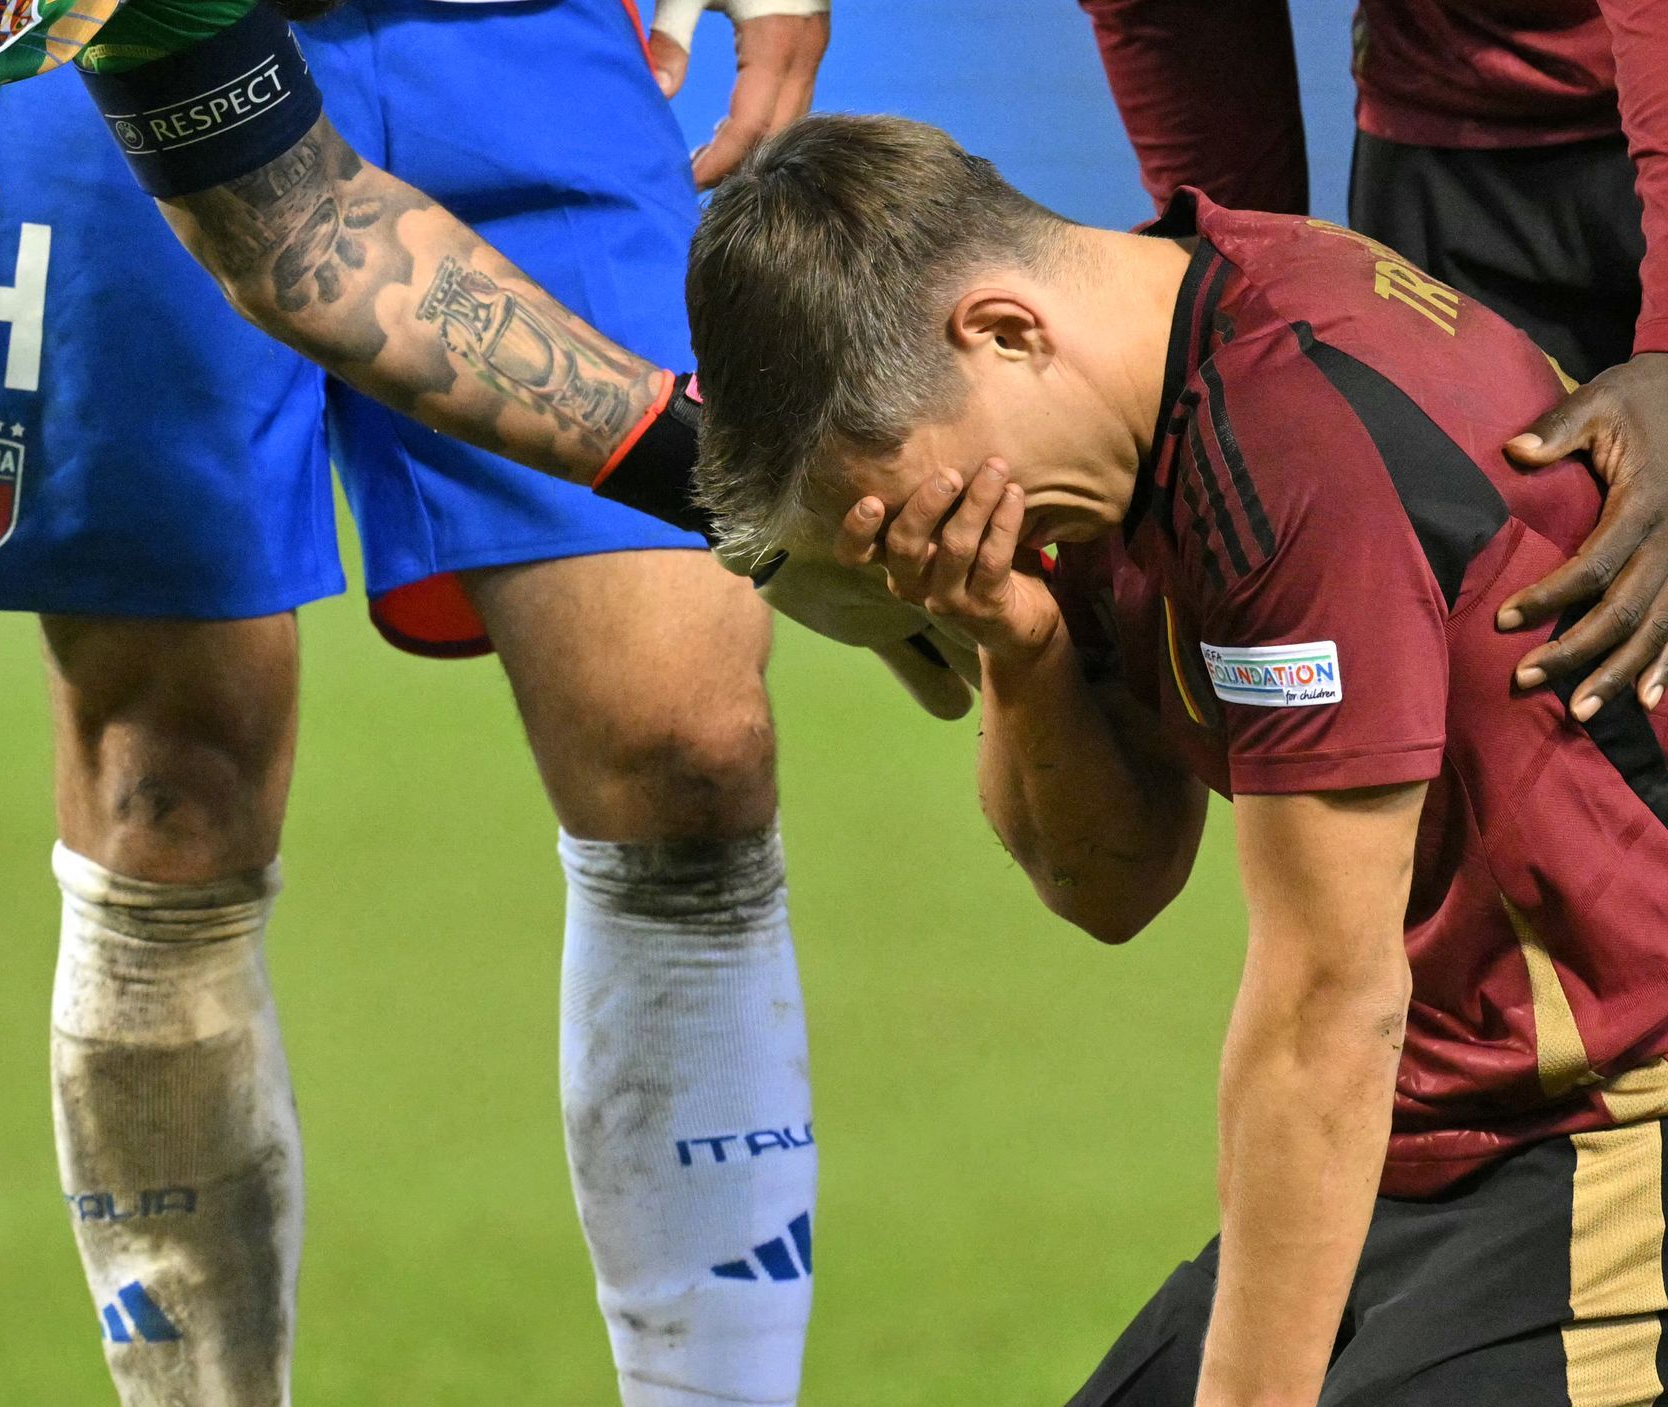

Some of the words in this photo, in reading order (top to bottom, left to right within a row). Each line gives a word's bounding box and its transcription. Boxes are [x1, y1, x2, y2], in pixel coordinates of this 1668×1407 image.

[149, 63, 282, 142] RESPECT
[1285, 691, 1297, 705] for
[1299, 690, 1336, 701] children
